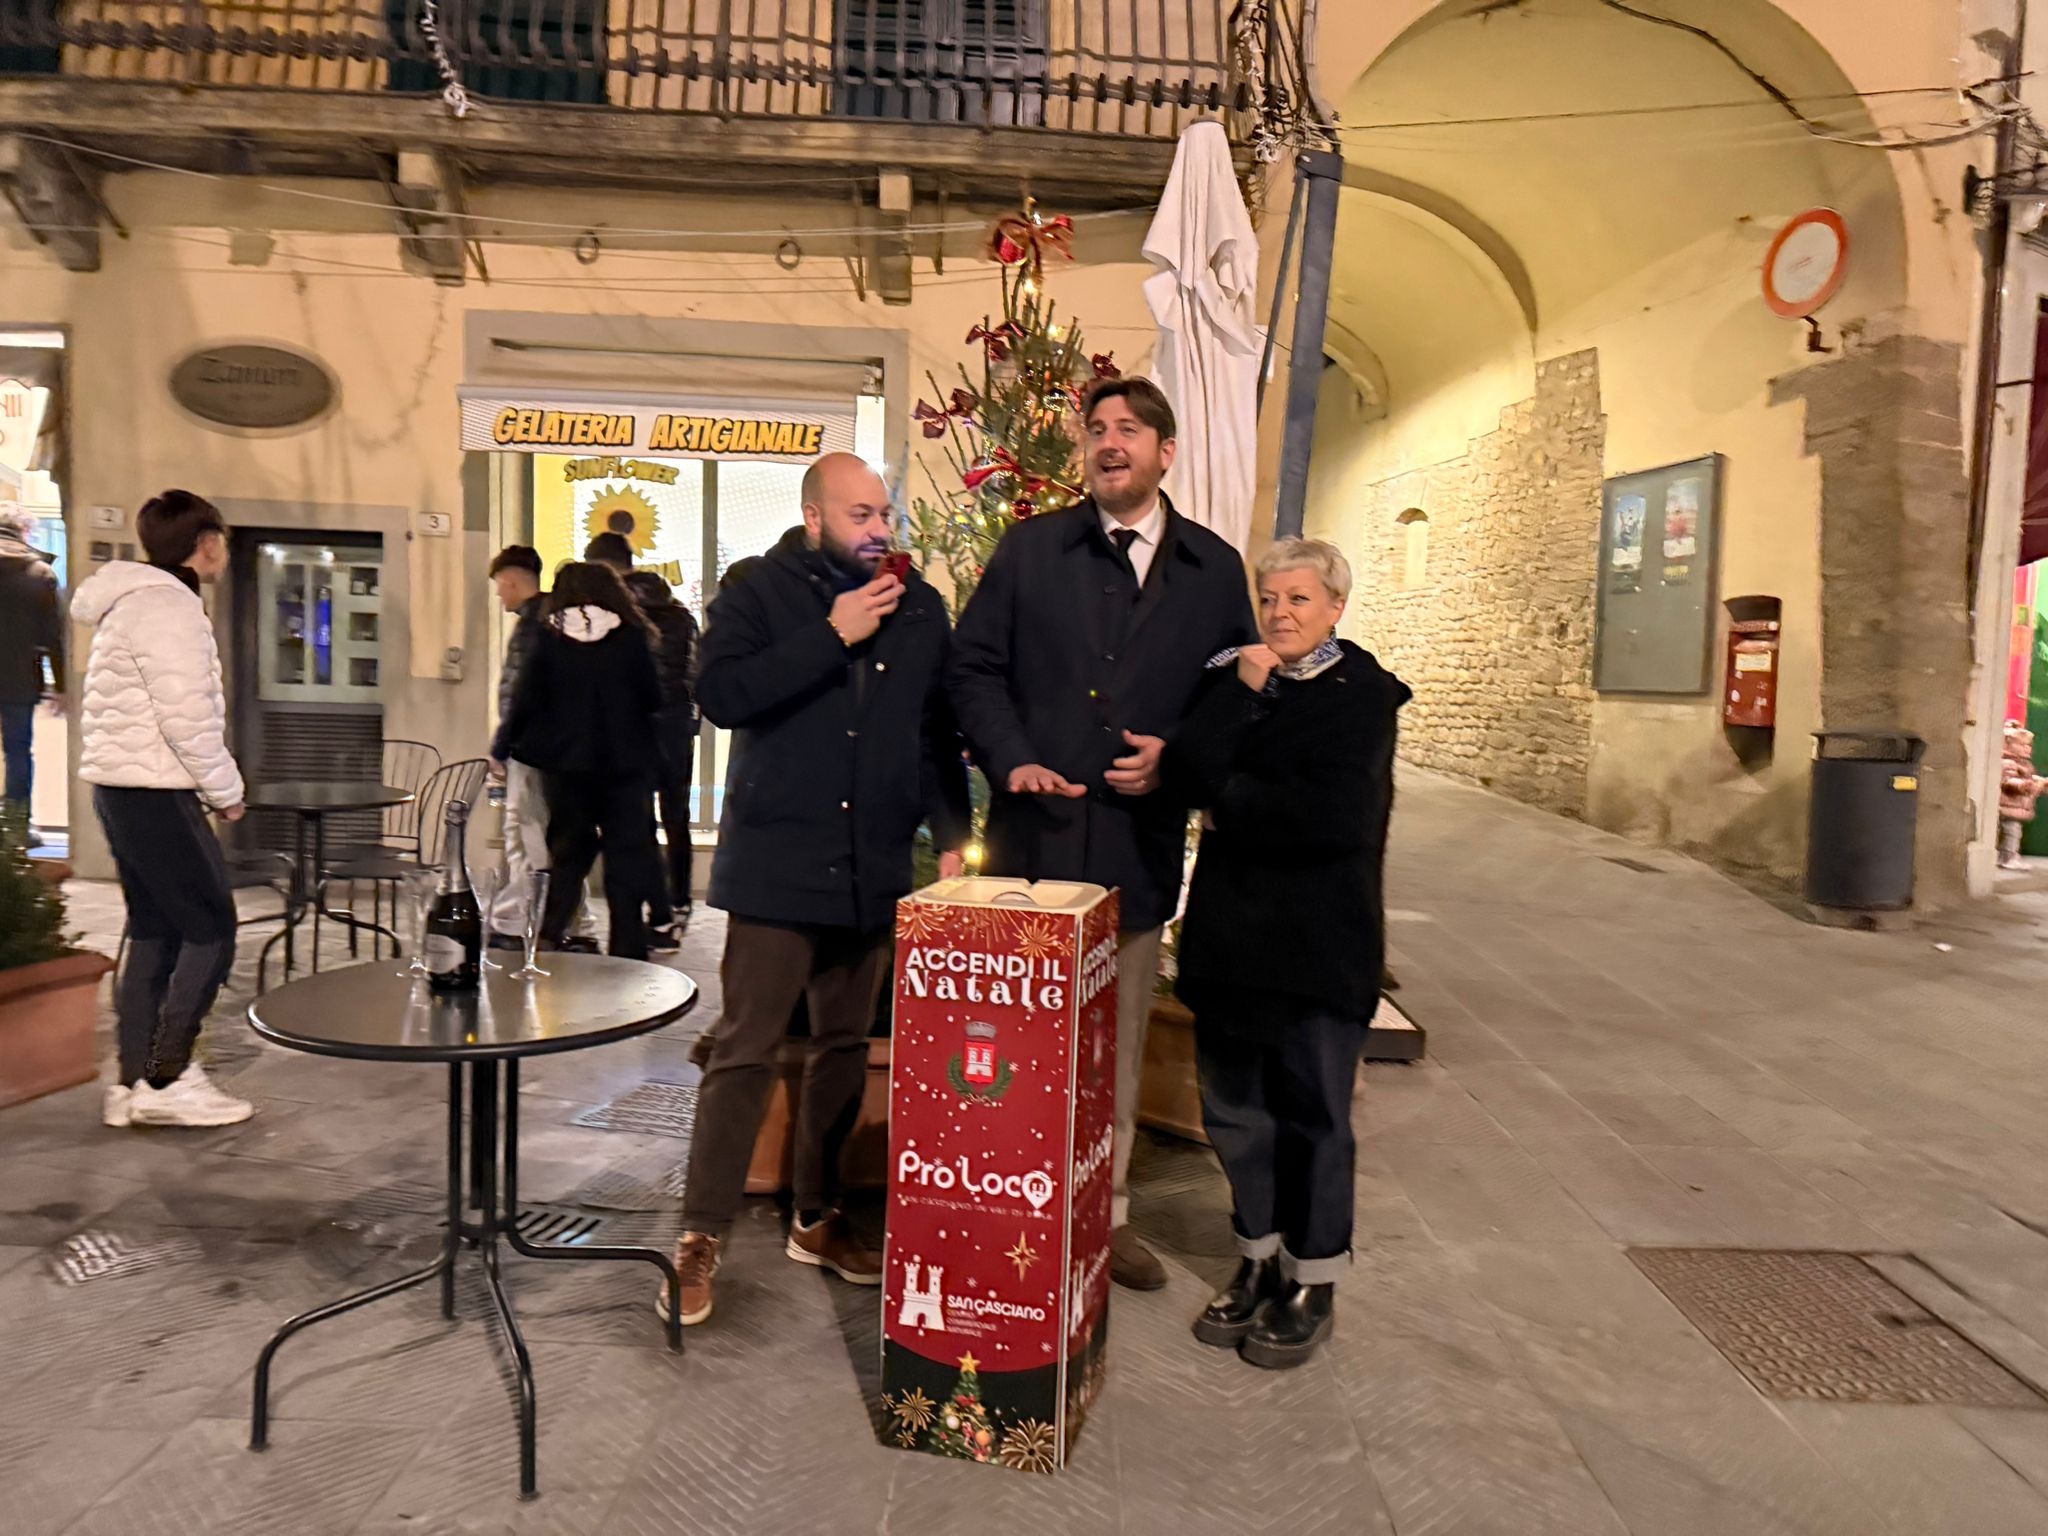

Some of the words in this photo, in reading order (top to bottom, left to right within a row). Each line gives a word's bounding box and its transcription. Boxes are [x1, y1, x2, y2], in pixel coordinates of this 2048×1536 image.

[494, 407, 635, 446] GELATERIA
[648, 414, 825, 455] ARTIGIANALE
[563, 455, 680, 485] SUNFLOWER
[429, 515, 440, 529] 3
[905, 947, 1034, 979] ACCENDI
[1042, 958, 1068, 982] IL
[903, 967, 1064, 1011] Natale
